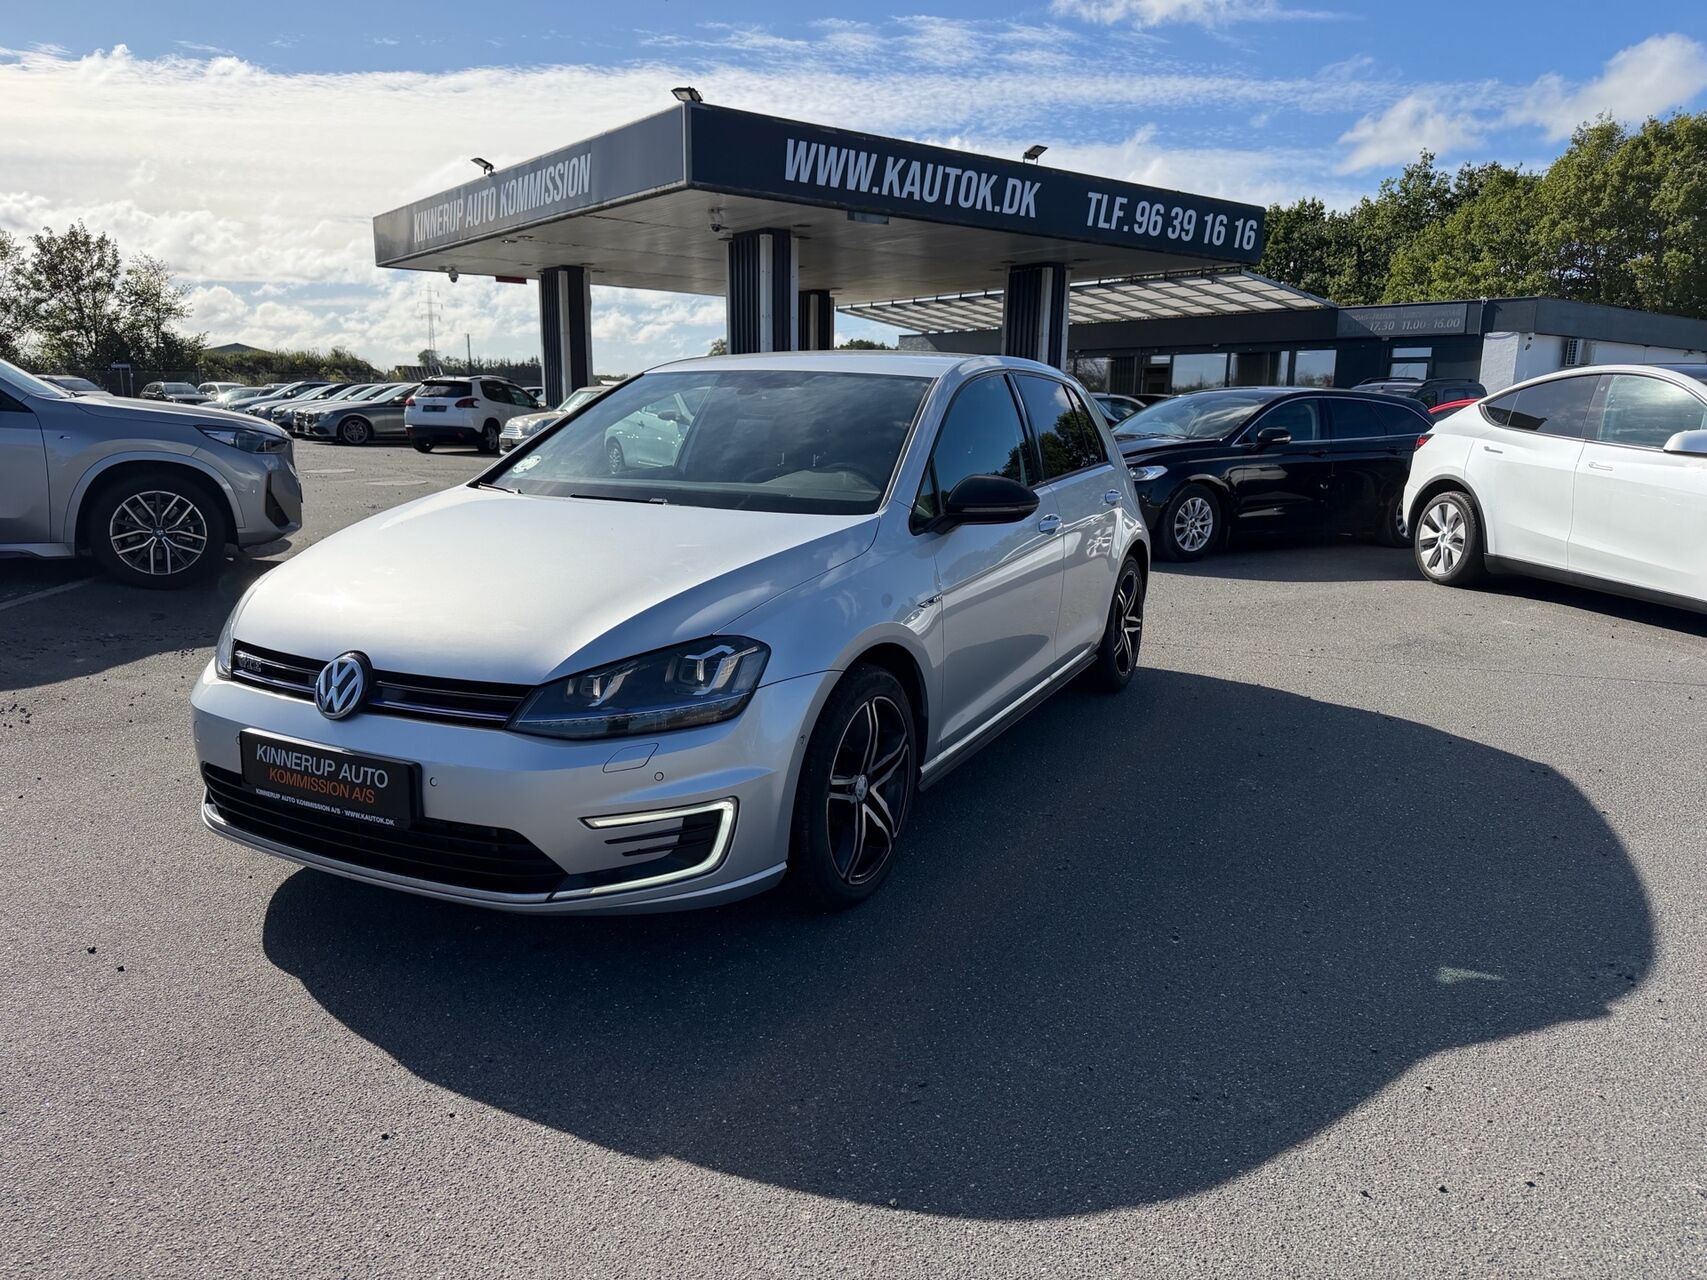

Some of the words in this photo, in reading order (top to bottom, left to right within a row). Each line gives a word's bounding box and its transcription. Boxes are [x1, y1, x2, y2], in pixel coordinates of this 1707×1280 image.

[413, 199, 463, 243] KINNERUP
[465, 186, 496, 229] AUTO
[499, 153, 591, 218] KOMMISSION
[784, 138, 1041, 218] WWW.KAUTOK.DK
[1087, 191, 1129, 232] TLF.
[1134, 200, 1165, 237] 96
[1167, 207, 1197, 242] 39
[1203, 213, 1226, 246] 16
[1234, 218, 1258, 251] 16
[256, 743, 336, 777] KINNERUP
[339, 765, 388, 788] AUTO
[269, 767, 350, 798] KOMMISSION
[352, 785, 375, 804] A/S
[255, 787, 281, 800] KINNERUP
[281, 794, 296, 804] AUTO
[296, 798, 331, 812] KOMMISSION
[344, 809, 395, 826] WWW.KAUTOK.DK
